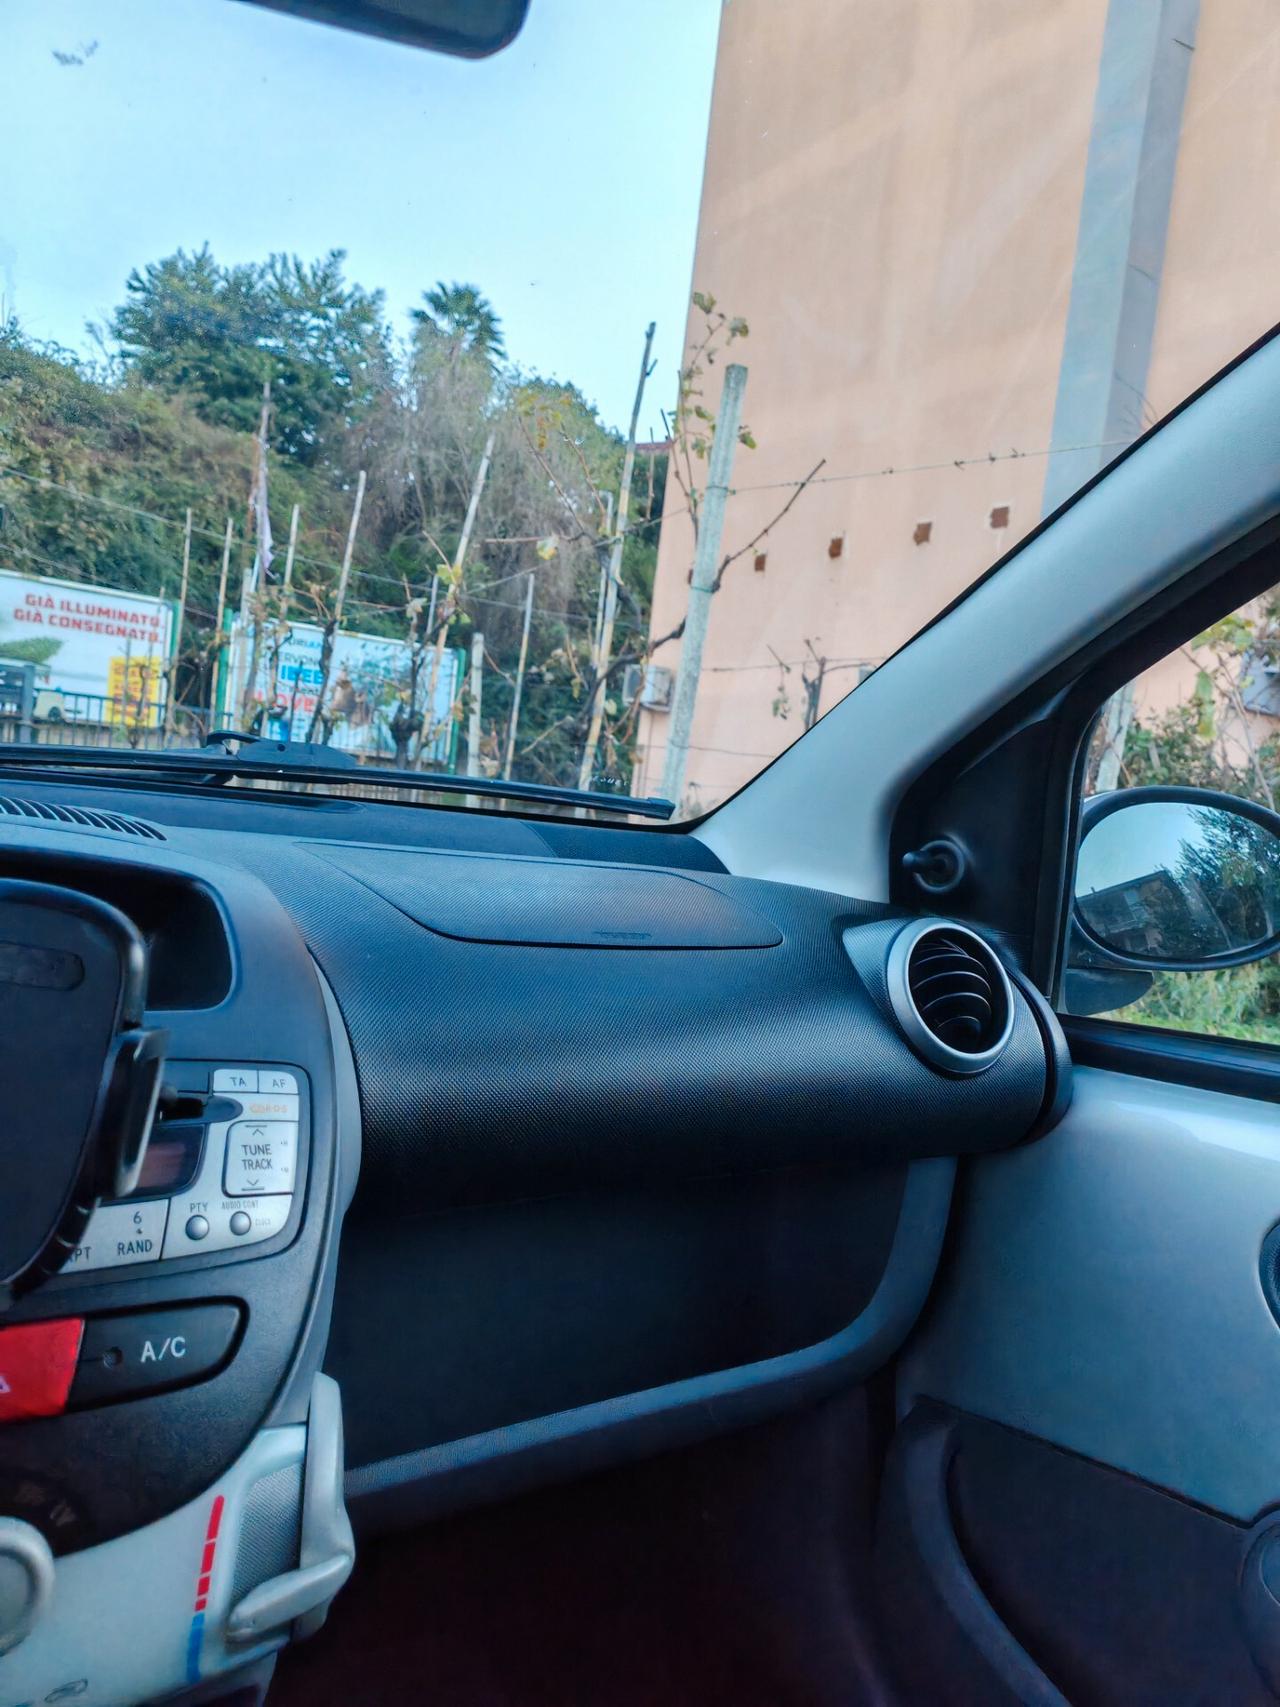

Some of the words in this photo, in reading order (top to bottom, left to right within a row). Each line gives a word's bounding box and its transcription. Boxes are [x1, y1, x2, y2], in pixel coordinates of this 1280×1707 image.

[25, 593, 55, 608] GIÀ
[14, 607, 43, 624] GIÀ
[229, 1077, 247, 1087] TA
[272, 1079, 287, 1088] AF
[241, 1144, 273, 1156] TUNE
[241, 1159, 273, 1171] TRACK
[189, 1202, 209, 1213] PTY
[133, 1211, 142, 1225] 6
[68, 1246, 92, 1263] PT
[117, 1239, 153, 1257] RAND
[140, 1336, 187, 1363] A/C
